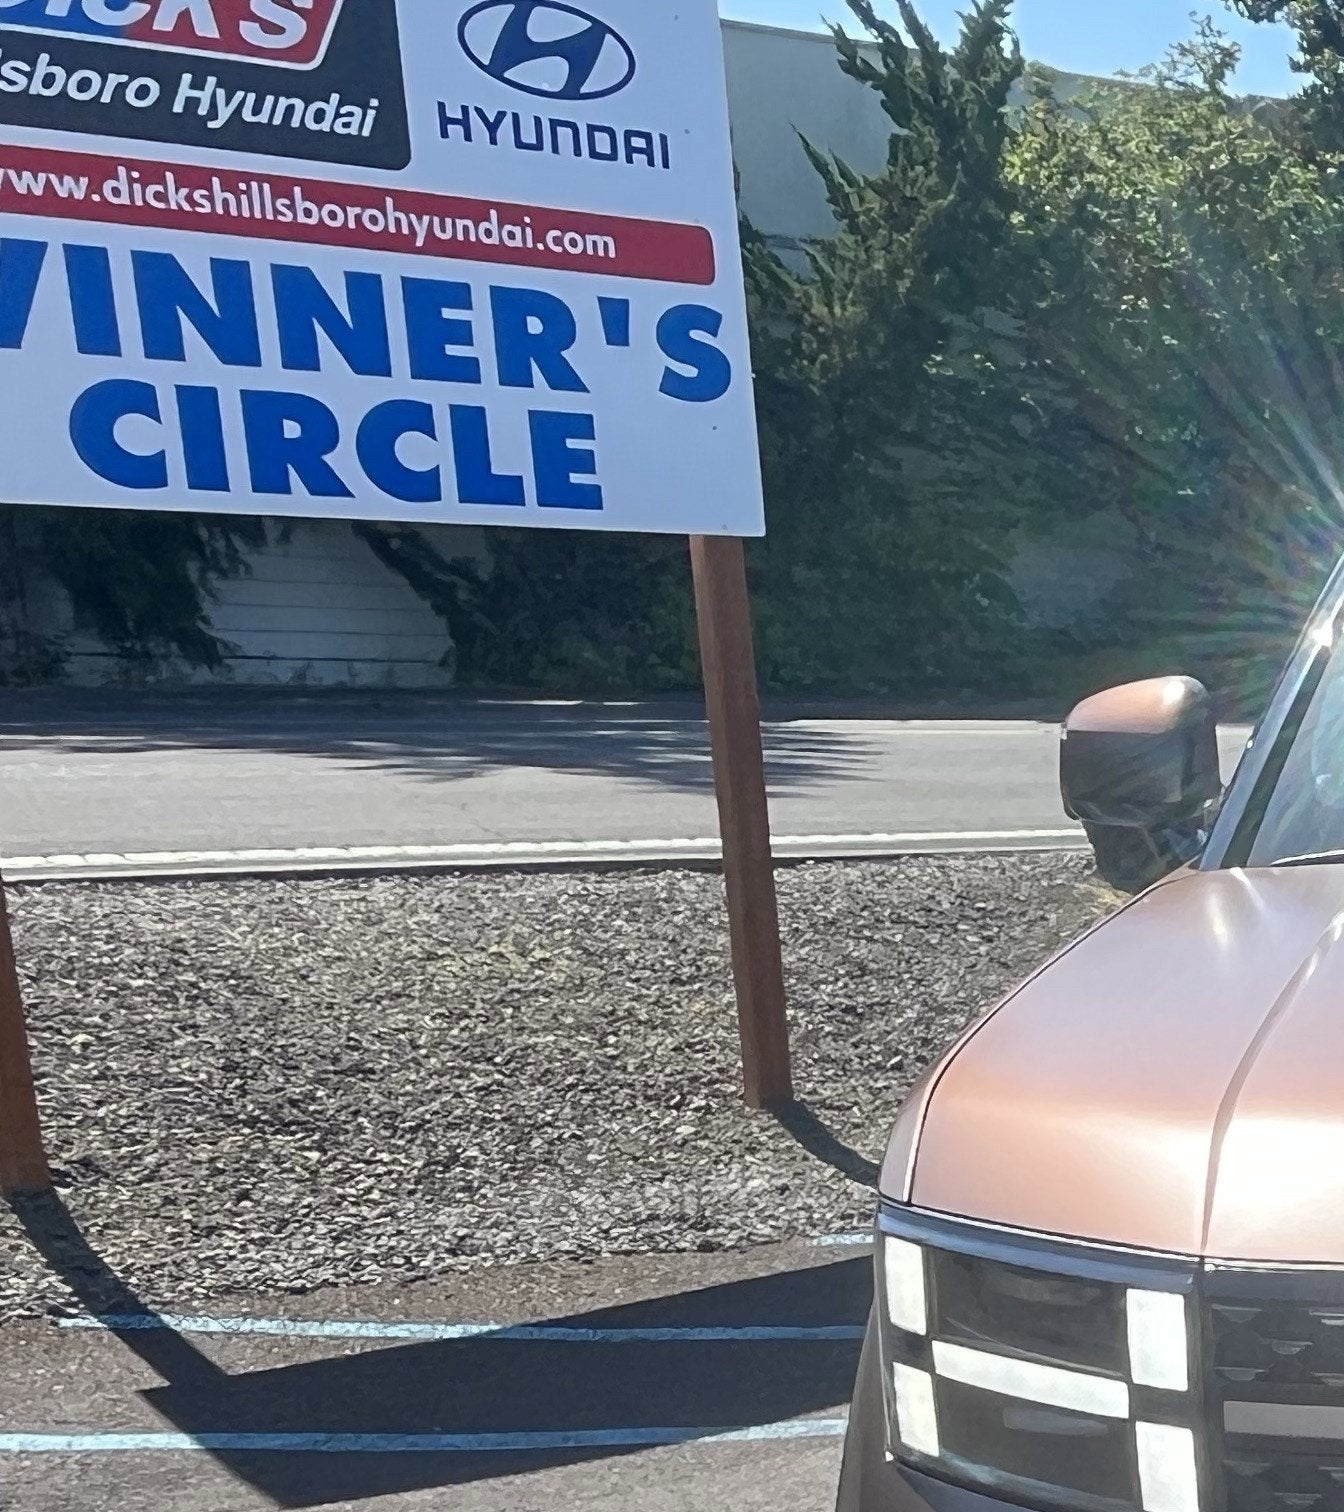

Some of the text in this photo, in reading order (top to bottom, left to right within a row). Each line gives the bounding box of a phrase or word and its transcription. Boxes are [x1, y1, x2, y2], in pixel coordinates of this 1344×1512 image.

[0, 48, 380, 138] sboro Hyundai
[437, 100, 672, 171] HYUNDAI
[68, 378, 604, 511] CIRCLE
